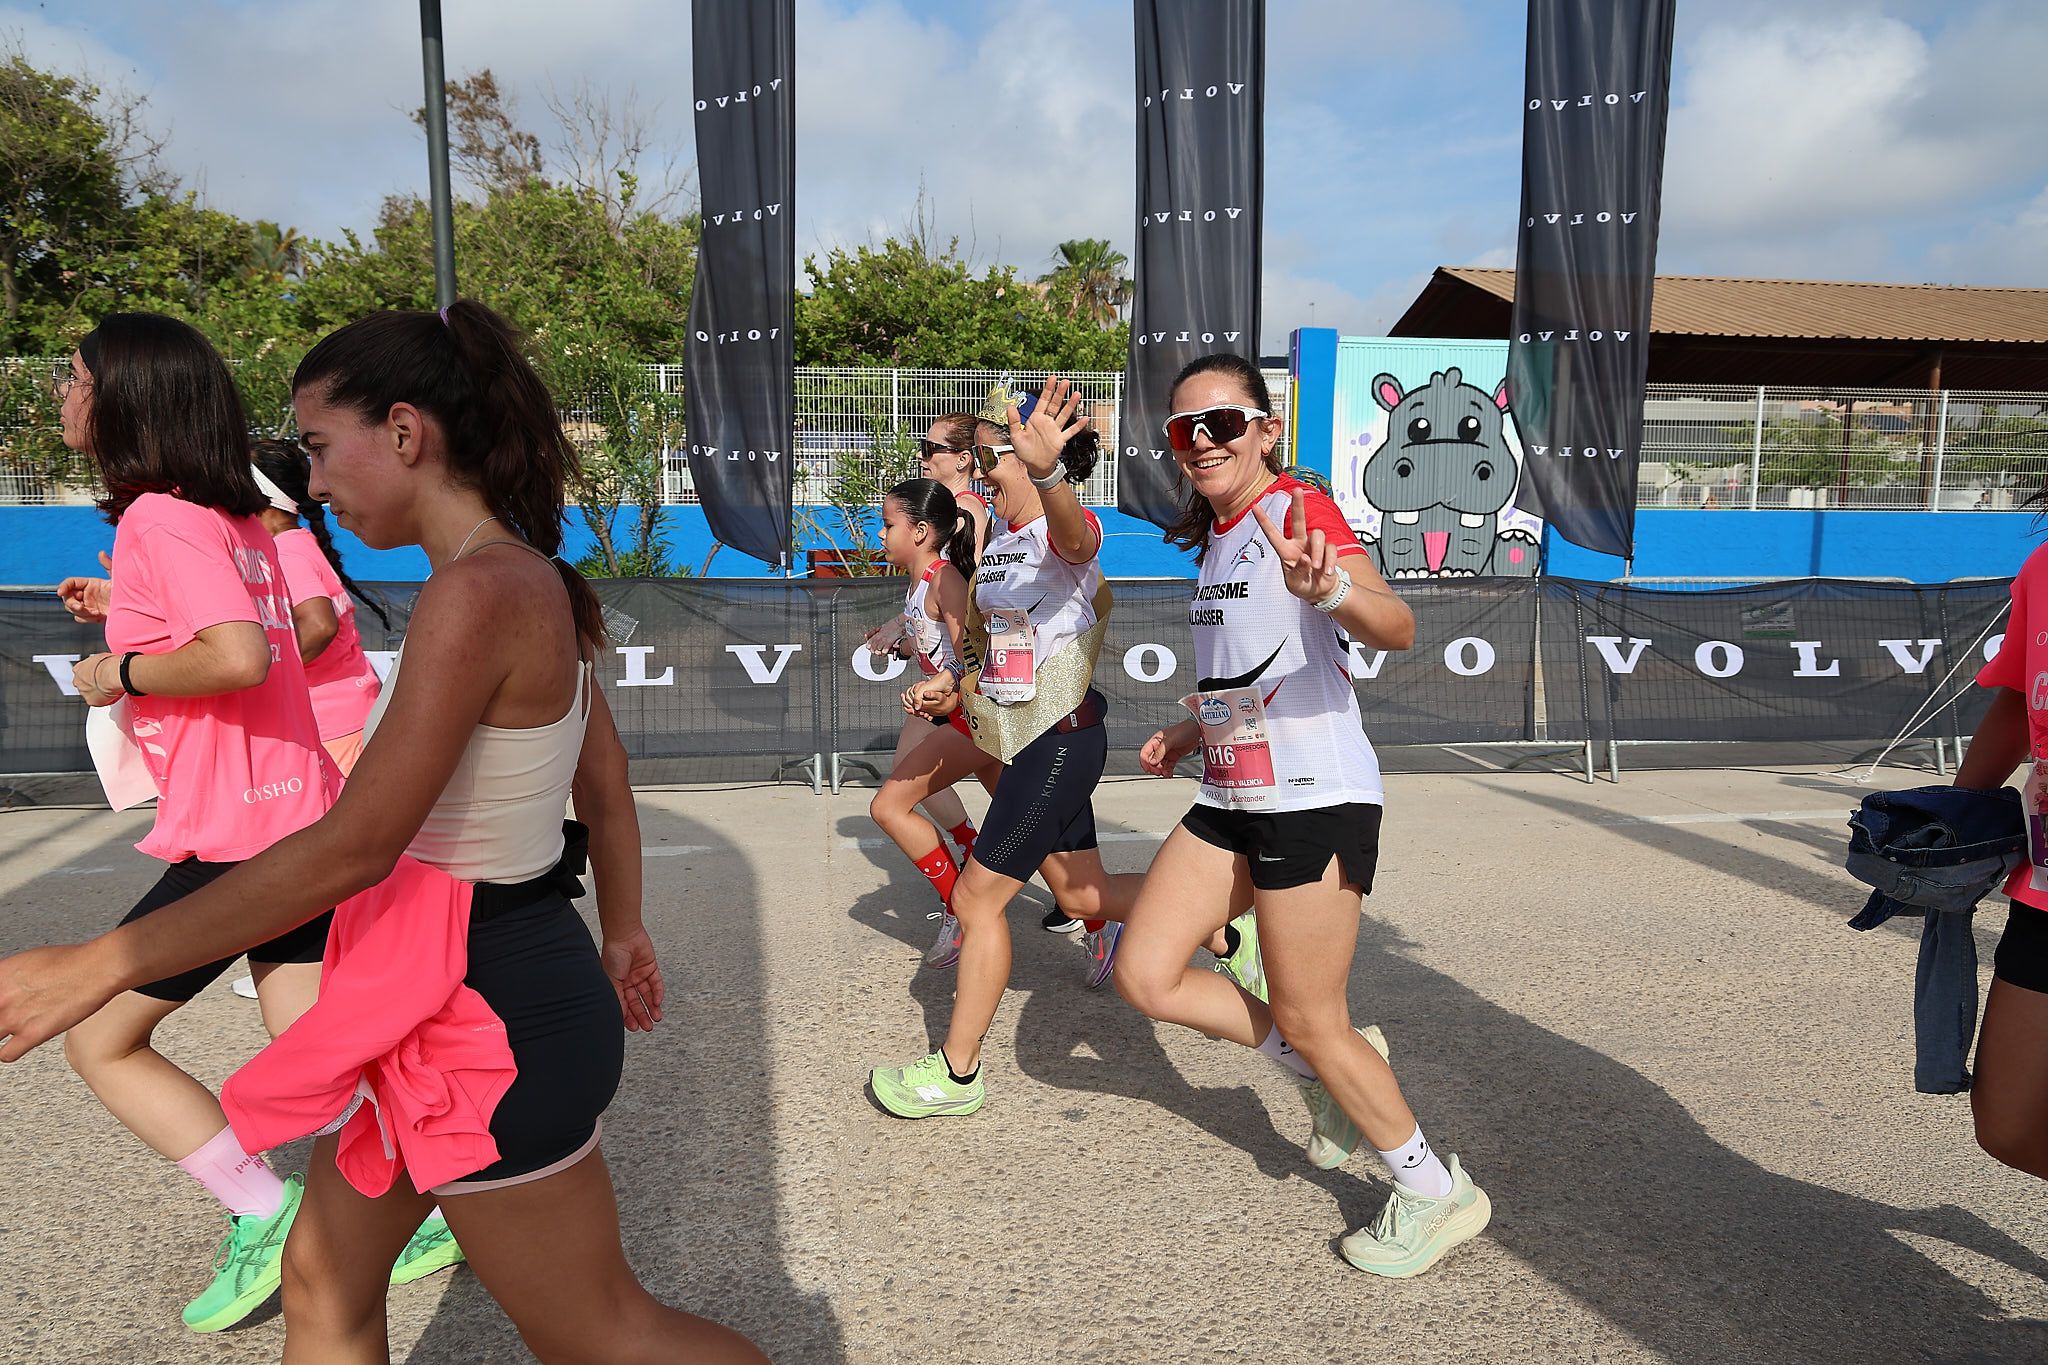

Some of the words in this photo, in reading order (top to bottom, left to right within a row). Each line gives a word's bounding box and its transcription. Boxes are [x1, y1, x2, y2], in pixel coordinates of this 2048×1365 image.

[990, 650, 1007, 665] 16
[1201, 710, 1230, 719] ASTURIANA
[1208, 745, 1236, 765] 016
[1041, 746, 1068, 797] KIPRUN
[1423, 1201, 1460, 1239] HOKA
